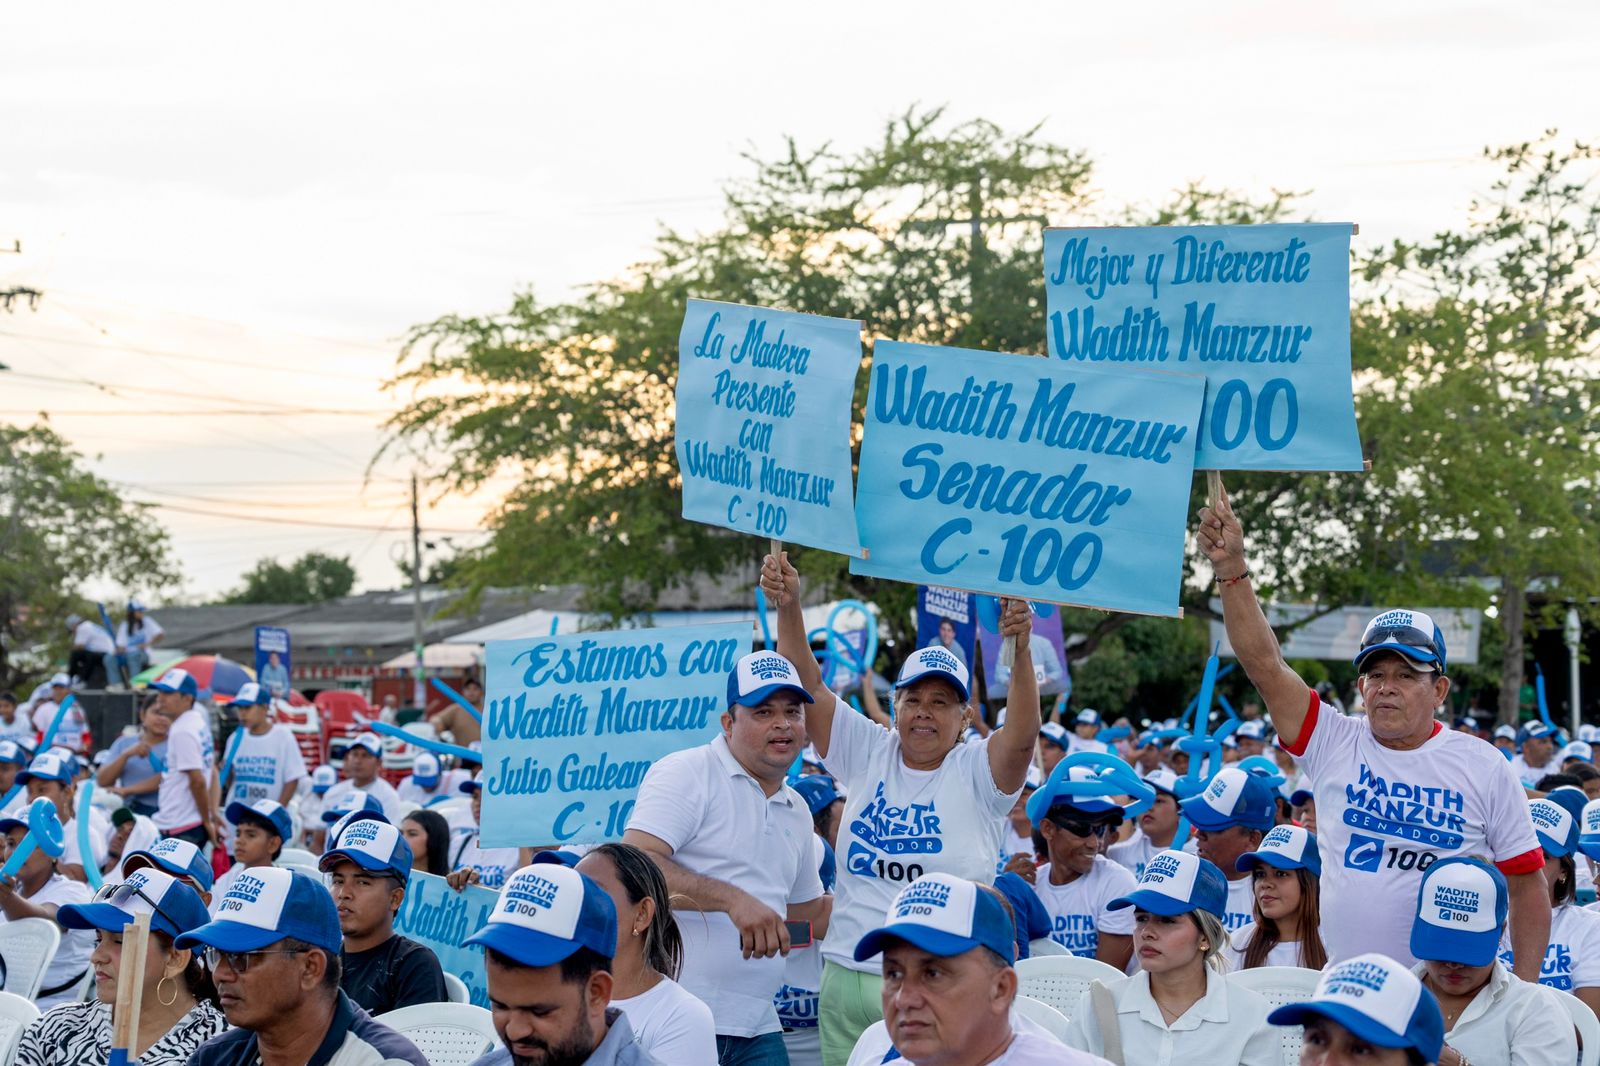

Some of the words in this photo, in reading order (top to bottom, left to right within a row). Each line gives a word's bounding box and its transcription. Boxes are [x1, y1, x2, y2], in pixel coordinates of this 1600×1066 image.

[1051, 236, 1134, 300] Mejor
[1145, 253, 1164, 299] y
[1170, 235, 1311, 286] Diferente
[694, 312, 725, 360] La
[731, 319, 811, 375] Madera
[1050, 305, 1169, 362] Wadith
[1178, 301, 1312, 363] Manzur
[712, 369, 796, 418] Presente
[875, 363, 1017, 440] Wadith
[1019, 378, 1187, 464] Manzur
[1198, 378, 1298, 451] 00
[739, 419, 774, 454] con
[685, 440, 752, 490] Wadith
[760, 456, 834, 507] Manzur
[899, 443, 1132, 526] Senador
[1376, 611, 1412, 623] WADITH
[512, 640, 668, 688] Estamos
[679, 638, 738, 678] con
[751, 657, 788, 667] WADITH
[751, 663, 790, 672] MANZUR
[939, 662, 952, 673] 100
[773, 672, 788, 680] 100
[488, 692, 588, 740] Wadith
[595, 687, 718, 737] Manzur
[488, 757, 552, 796] Julio
[557, 752, 652, 792] Galean
[1358, 764, 1464, 813] WADITH
[1346, 784, 1467, 832] MANZUR
[1530, 808, 1560, 823] ANZUR
[1350, 813, 1455, 847] SENADOR
[1536, 820, 1549, 829] 100
[1387, 847, 1438, 872] 100
[877, 860, 923, 883] 100
[1150, 874, 1164, 883] 100
[1434, 893, 1479, 908] MANZUR
[1437, 885, 1479, 900] WADITH
[226, 901, 243, 911] 100
[516, 903, 537, 917] 100
[911, 905, 932, 915] 100
[1452, 912, 1469, 922] 100
[1052, 932, 1098, 949] NZUR
[1341, 985, 1365, 997] 100
